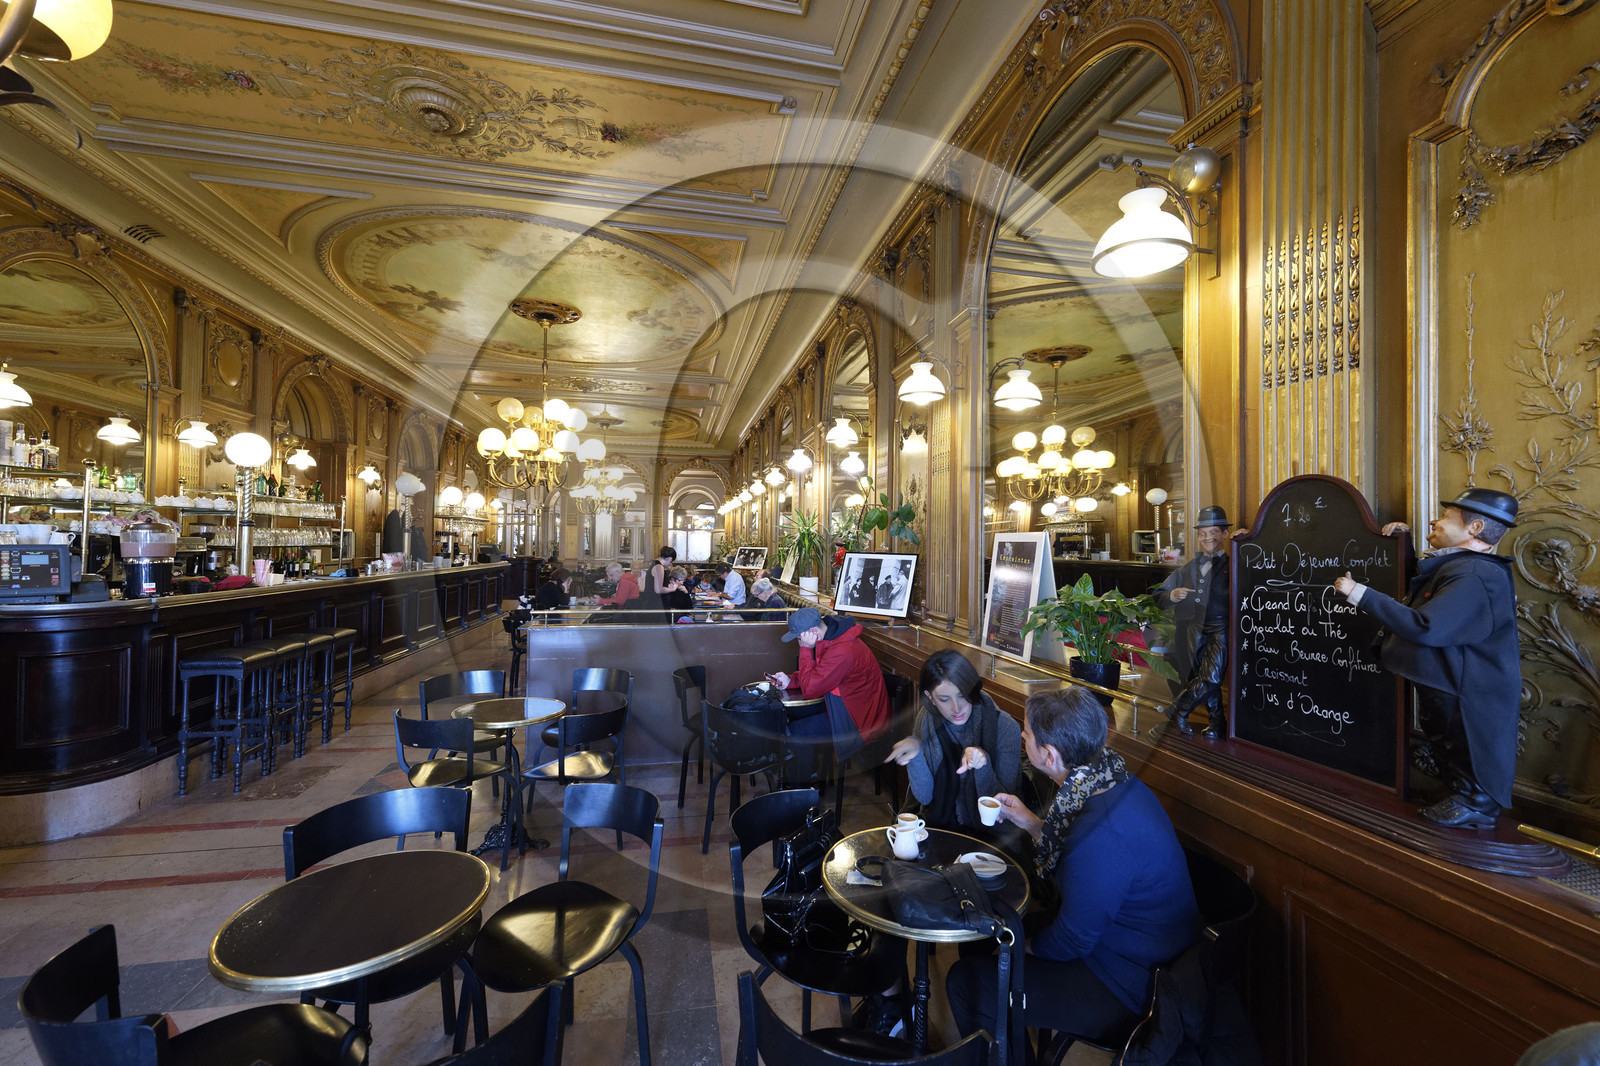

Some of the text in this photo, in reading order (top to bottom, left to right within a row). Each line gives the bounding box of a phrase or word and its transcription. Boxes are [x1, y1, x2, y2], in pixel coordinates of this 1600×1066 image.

[1239, 543, 1276, 570] Petit
[1342, 539, 1392, 576] Complet
[1250, 586, 1290, 620] Grand
[1240, 613, 1347, 640] Chocolat ou Thé
[1254, 632, 1381, 682] Pain Beurre Confiture
[1255, 657, 1308, 686] Croissant
[1253, 683, 1280, 711] Jus
